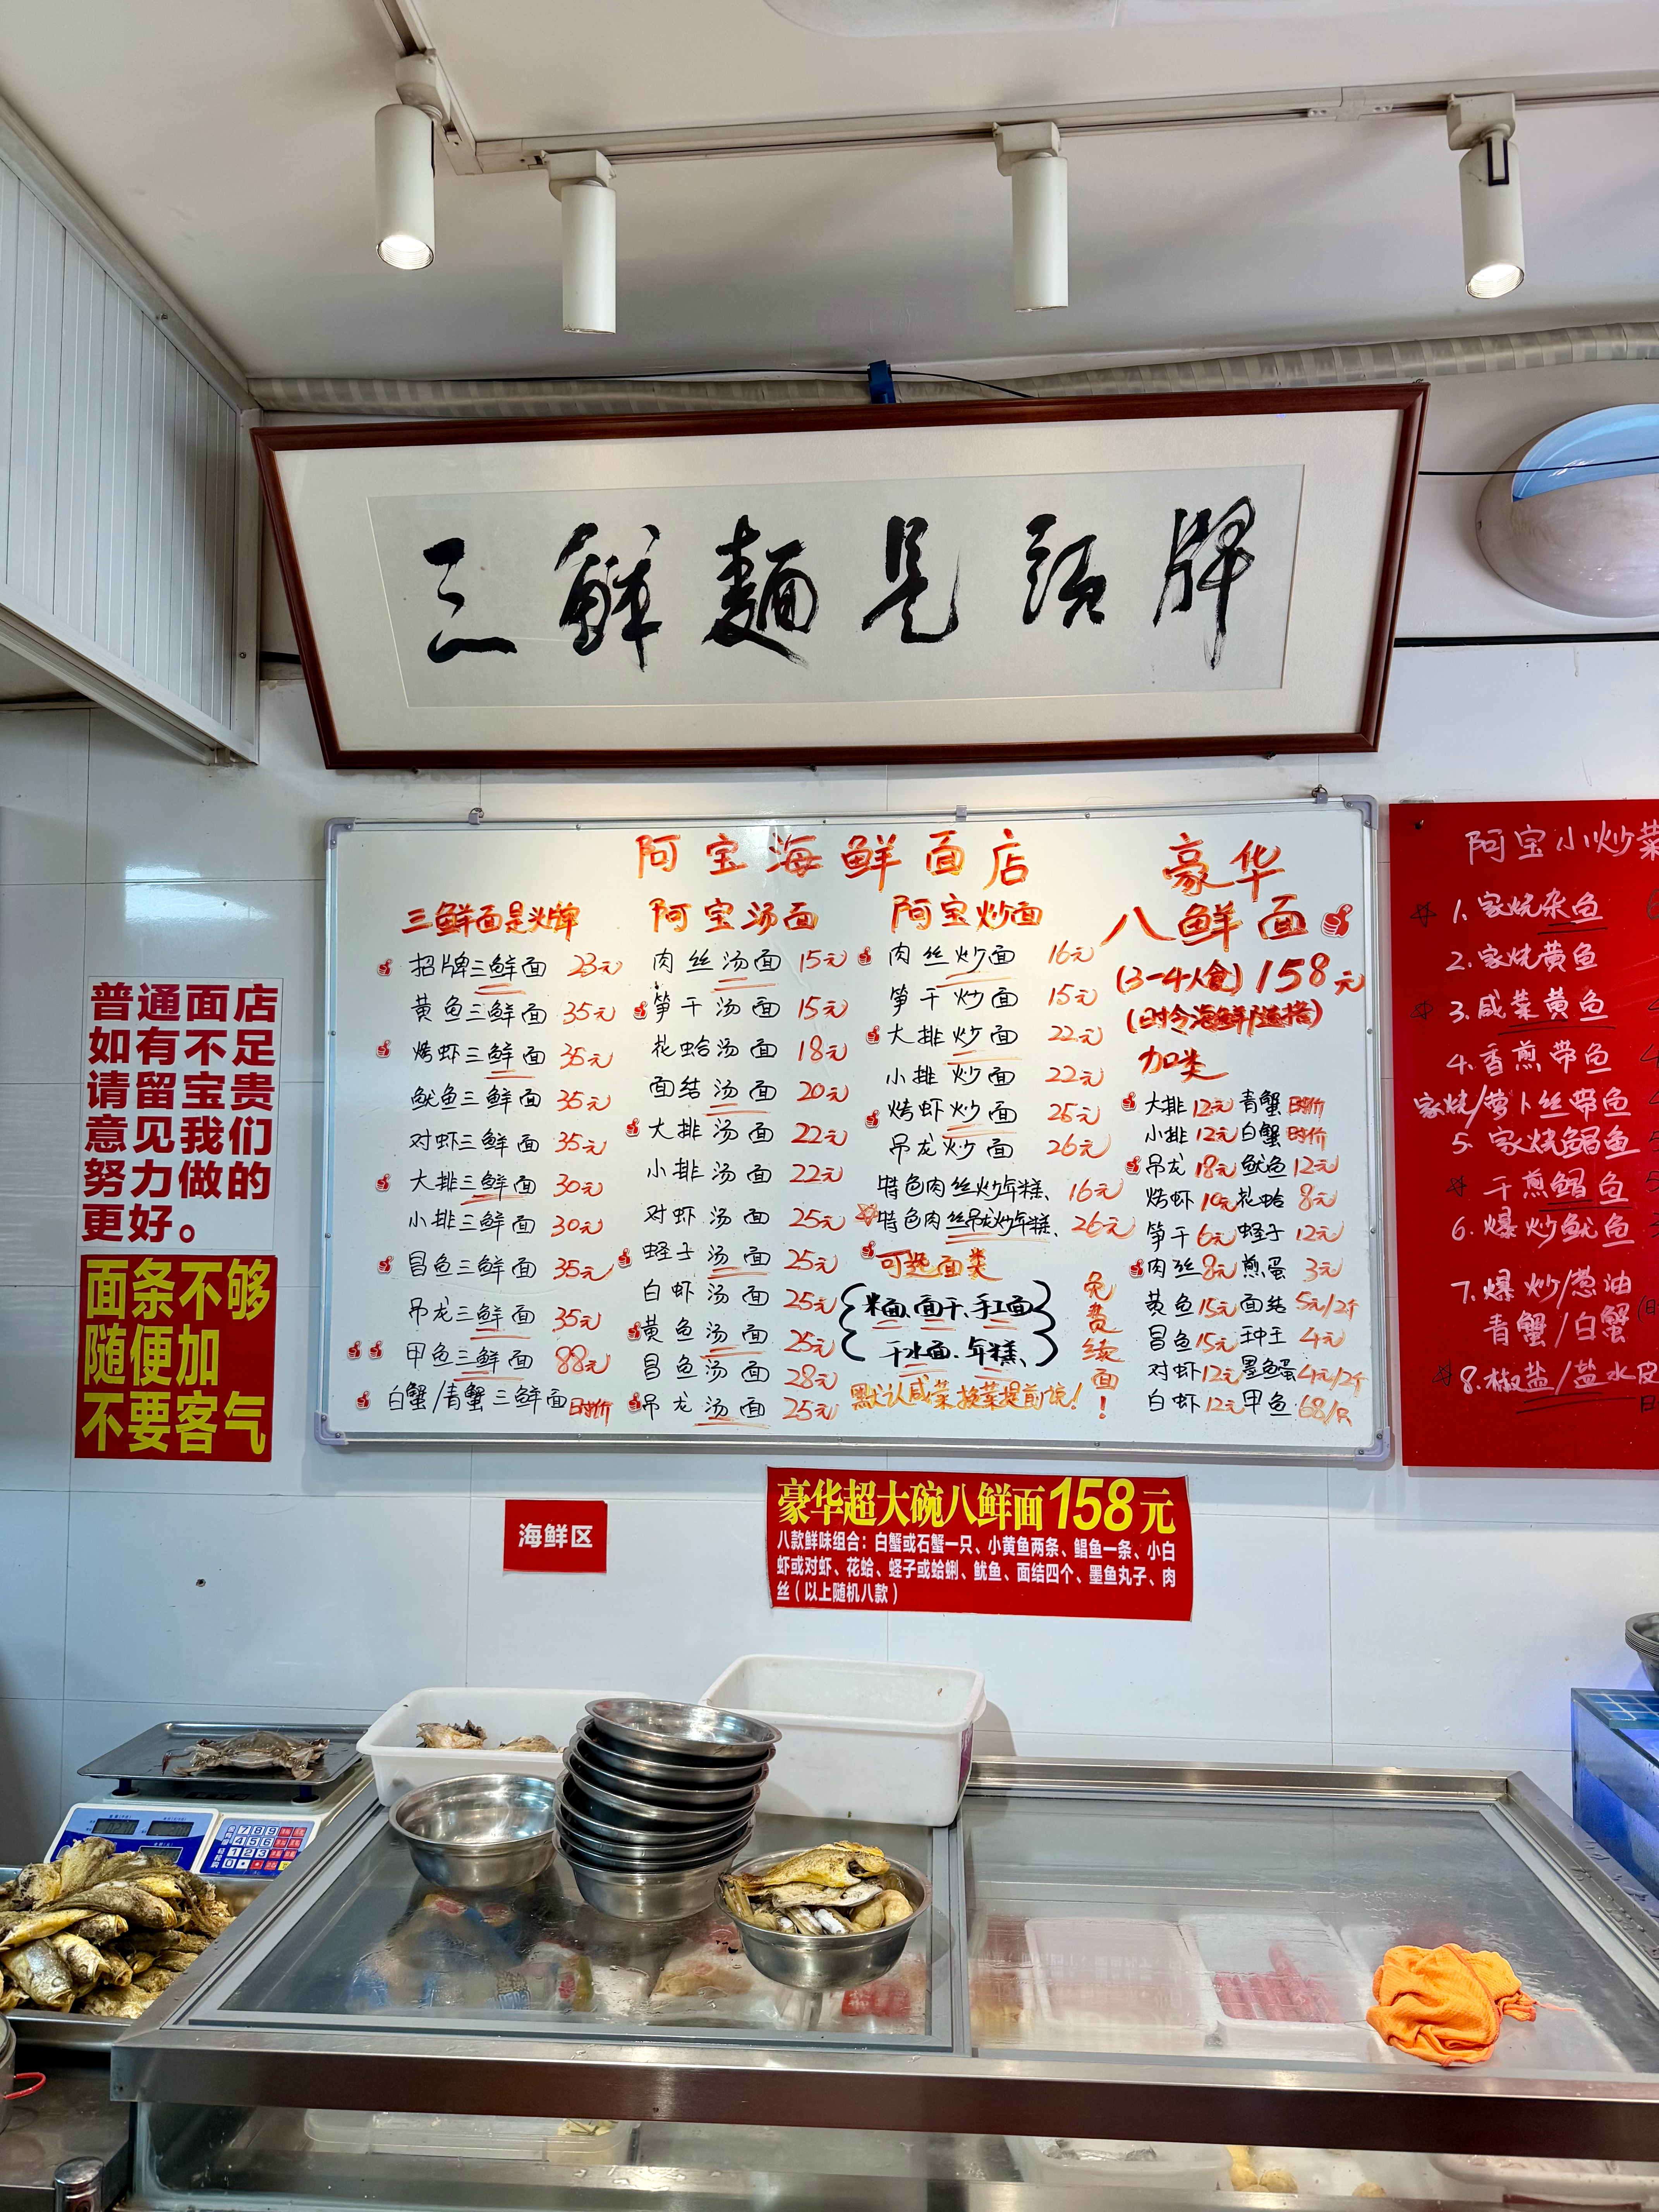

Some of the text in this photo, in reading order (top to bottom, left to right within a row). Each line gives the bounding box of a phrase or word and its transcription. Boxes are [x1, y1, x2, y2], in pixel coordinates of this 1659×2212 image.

[1465, 819, 1659, 865] 阿宝小炒菜
[634, 828, 1029, 895] 阿宝海鲜面店
[1161, 832, 1288, 905] 豪华
[401, 900, 581, 942] 三鲜面是头牌
[648, 897, 819, 936] 阿宝汤面
[891, 893, 1044, 934] 阿宝炒面
[1098, 891, 1309, 953] 八鲜面
[409, 951, 623, 981] 招牌三鲜面 23元
[653, 948, 848, 974] 肉丝汤面 15元
[889, 940, 1094, 972] 肉丝炒面 16元
[1255, 952, 1366, 996] 158元
[91, 982, 278, 1023] 普通面店
[410, 993, 616, 1028] 黄鱼三鲜面 35元
[654, 991, 848, 1023] 笋干汤面 15元
[890, 983, 1098, 1017] 笋干炒面 15元
[89, 1026, 275, 1066] 如有不足
[651, 1034, 848, 1063] 花蛤汤面 18元
[887, 1023, 1103, 1048] 大排炒面 22元
[412, 1040, 613, 1070] 烤虾三鲜面 35元
[87, 1070, 275, 1111] 请留宝贵
[649, 1075, 849, 1103] 面结汤面 20元
[886, 1065, 1104, 1087] 小排炒面 22元
[411, 1083, 611, 1115] 鱿鱼三鲜面 35元
[888, 1098, 1017, 1124] 烤虾炒面
[1145, 1091, 1187, 1116] 大排
[1192, 1098, 1234, 1118] 12元
[1239, 1089, 1281, 1117] 青蟹
[85, 1113, 272, 1155] 意见我们
[409, 1128, 607, 1158] 对虾三鲜面 35元
[648, 1116, 848, 1147] 大排汤面 22元
[1145, 1124, 1188, 1145] 小排
[1195, 1127, 1239, 1144] 12元
[1242, 1121, 1281, 1147] 白蟹
[889, 1132, 1111, 1165] 吊龙炒面 26元
[83, 1158, 271, 1200] 努力做的
[647, 1157, 843, 1185] 小排汤面 22元
[1146, 1152, 1339, 1179] 吊龙 18元 鱿鱼 12元
[410, 1168, 603, 1202] 大排三鲜面 30元
[1068, 1178, 1123, 1203] 16元
[1146, 1183, 1336, 1212] 烤虾 10元 花蛤 8元
[82, 1204, 195, 1243] 更好。
[409, 1208, 603, 1242] 小排三鲜面 30元
[644, 1204, 845, 1231] 对虾汤面 25元
[1071, 1211, 1136, 1240] 26元
[1147, 1221, 1344, 1252] 笋干 6元 蛏子 12元
[553, 1257, 614, 1281] 35元
[642, 1241, 838, 1274] 蛏子汤面 25元
[872, 1247, 1003, 1282] 可选面类
[1147, 1253, 1342, 1281] 肉丝 8元 煎蛋 3元
[87, 1257, 270, 1324] 面条不够
[644, 1278, 837, 1315] 白虾汤面 25元
[1144, 1288, 1194, 1317] 黄鱼
[1198, 1298, 1238, 1319] 15元
[1240, 1293, 1286, 1314] 面结
[409, 1296, 601, 1333] 吊龙三鲜面 35元
[640, 1314, 835, 1358] 黄鱼汤面 25元
[1195, 1332, 1238, 1353] 15元
[1240, 1325, 1287, 1347] 王中王
[1299, 1327, 1345, 1350] 4元
[84, 1322, 219, 1386] 随便加
[407, 1342, 611, 1374] 甲鱼三鲜面 88元
[1148, 1360, 1201, 1381] 对虾
[1202, 1365, 1243, 1385] 12元
[1241, 1355, 1297, 1382] 墨鱼蛋
[784, 1364, 838, 1391] 28元
[389, 1380, 567, 1415] 白蟹/青蟹三鲜面
[642, 1391, 838, 1421] 吊龙汤面 25元
[1148, 1390, 1200, 1414] 白虾
[1206, 1397, 1245, 1415] 12元
[1242, 1389, 1292, 1416] 甲鱼
[82, 1390, 266, 1455] 不要客气
[778, 1477, 1175, 1534] 豪华超大碗八鲜面158元
[518, 1523, 593, 1548] 海鲜区
